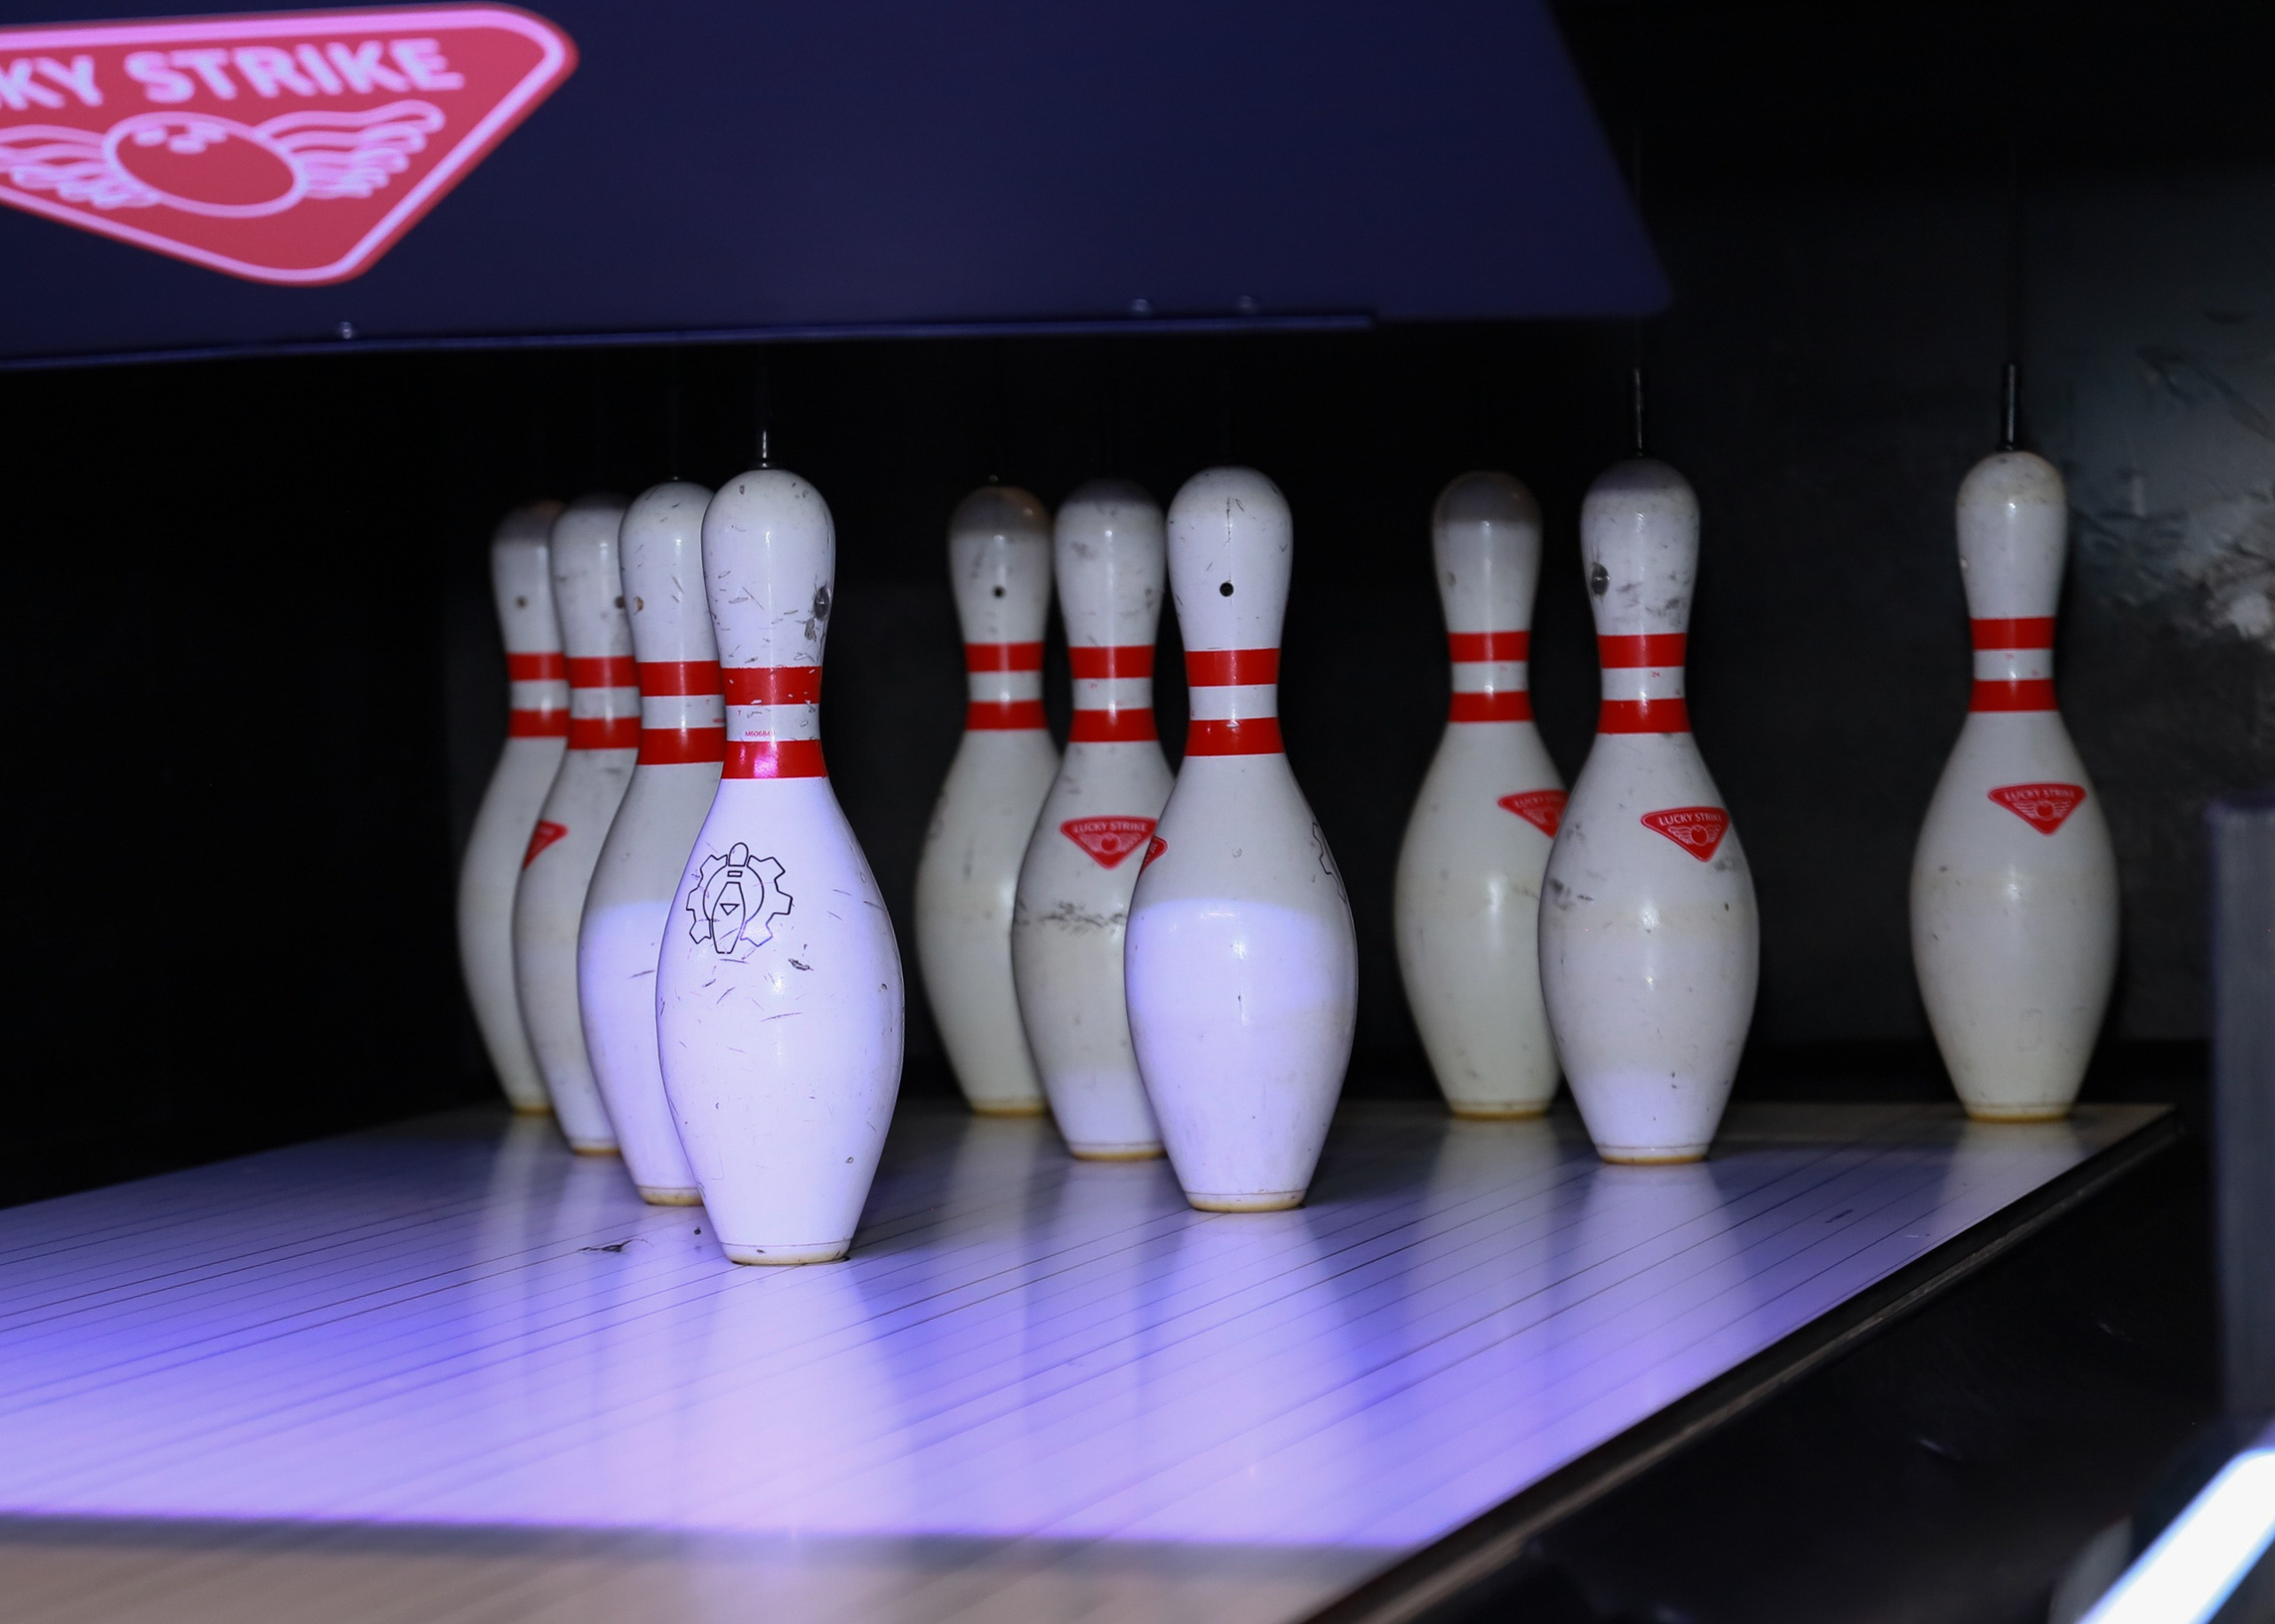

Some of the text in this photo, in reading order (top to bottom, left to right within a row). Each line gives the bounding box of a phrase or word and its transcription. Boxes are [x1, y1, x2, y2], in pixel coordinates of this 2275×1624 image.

[124, 37, 466, 104] STRIKE
[1657, 812, 1722, 826] LUCKY STRIKE
[1074, 821, 1147, 833] LUCKY STRIKE
